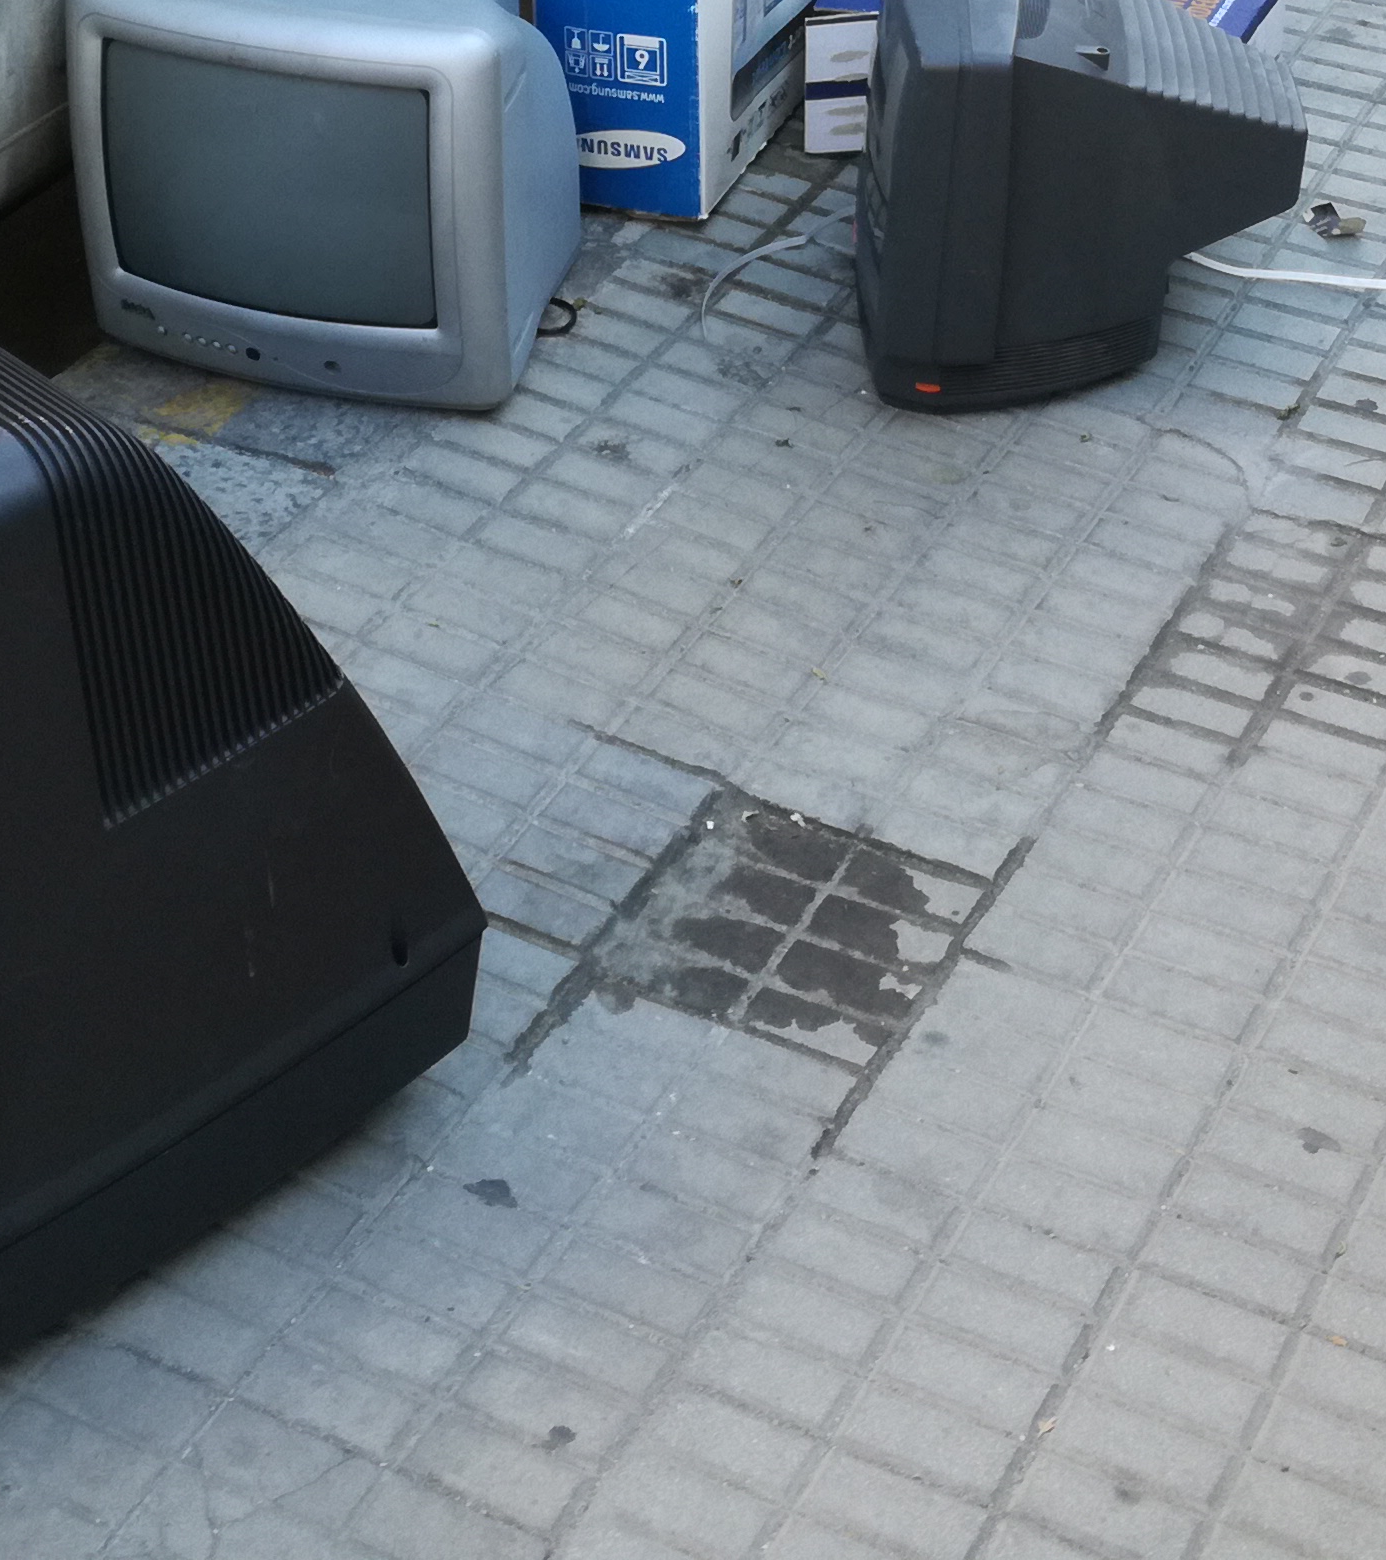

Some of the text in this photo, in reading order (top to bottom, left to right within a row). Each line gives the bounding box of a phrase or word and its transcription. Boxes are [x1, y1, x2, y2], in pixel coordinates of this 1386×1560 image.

[634, 50, 650, 70] 6
[568, 82, 665, 104] www.samsung.com
[575, 137, 669, 164] SAMSUN
